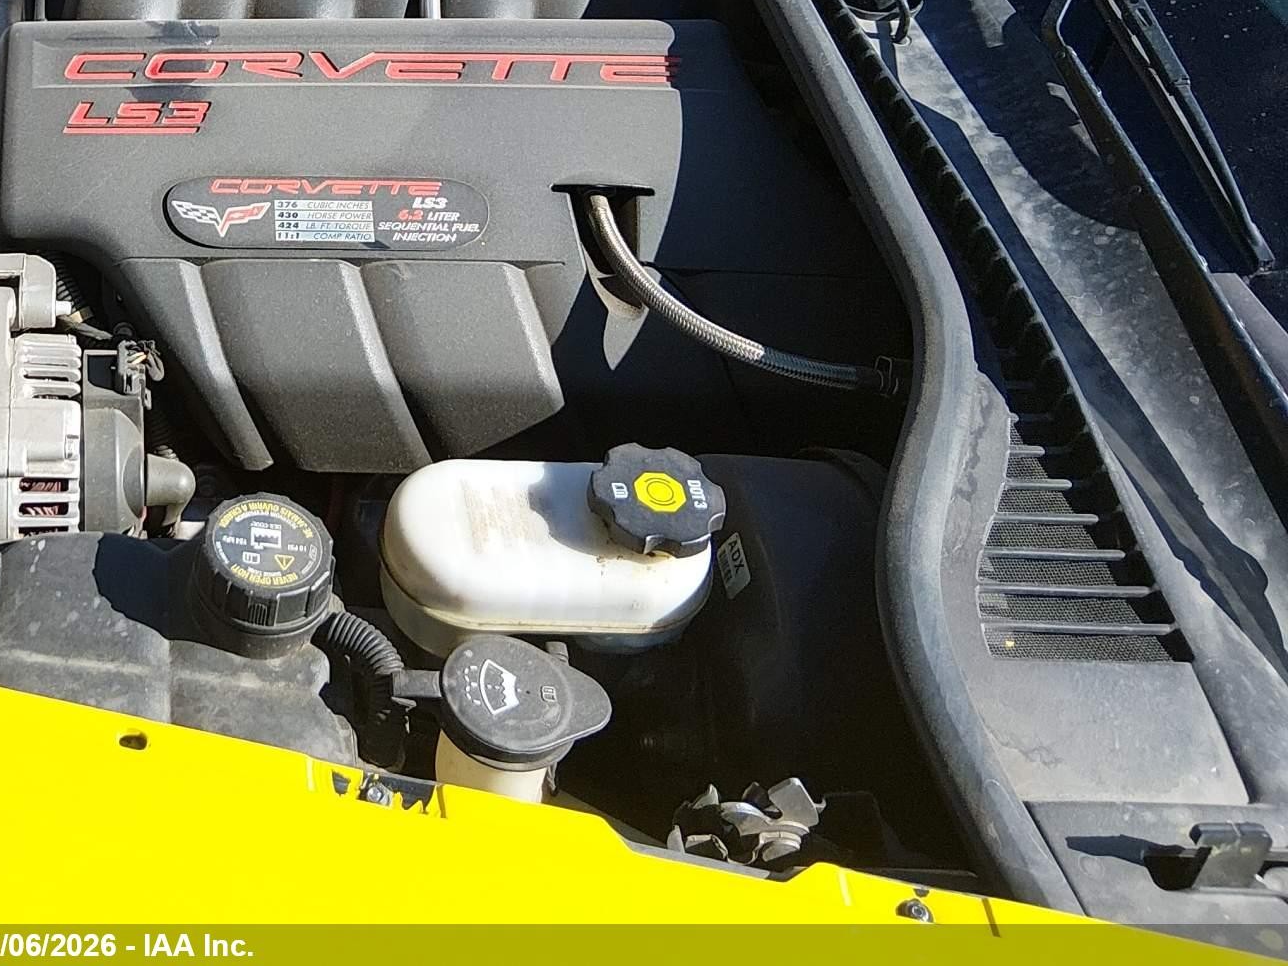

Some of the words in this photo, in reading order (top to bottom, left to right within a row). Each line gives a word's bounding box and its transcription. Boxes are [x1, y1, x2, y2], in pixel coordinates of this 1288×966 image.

[64, 52, 677, 83] CORVETTE
[66, 101, 212, 129] LS3
[211, 178, 442, 196] CORVETTE
[277, 201, 298, 209] 376
[307, 201, 334, 209] CUBIC
[335, 202, 370, 210] INCHES
[412, 197, 448, 209] LS3
[307, 212, 336, 220] HORSE
[339, 212, 373, 220] POWER
[398, 210, 424, 221] 6.2
[427, 211, 460, 222] LITER
[335, 222, 371, 230] TORQUE
[377, 221, 450, 232] SEQUENTIAL
[451, 222, 480, 233] FUEL
[344, 232, 372, 240] RATIO
[392, 232, 457, 242] INJECTION
[687, 479, 706, 500] DOT
[693, 499, 708, 509] 3
[728, 540, 744, 574] ADX
[249, 573, 272, 585] OPEN
[272, 572, 299, 585] NEVER
